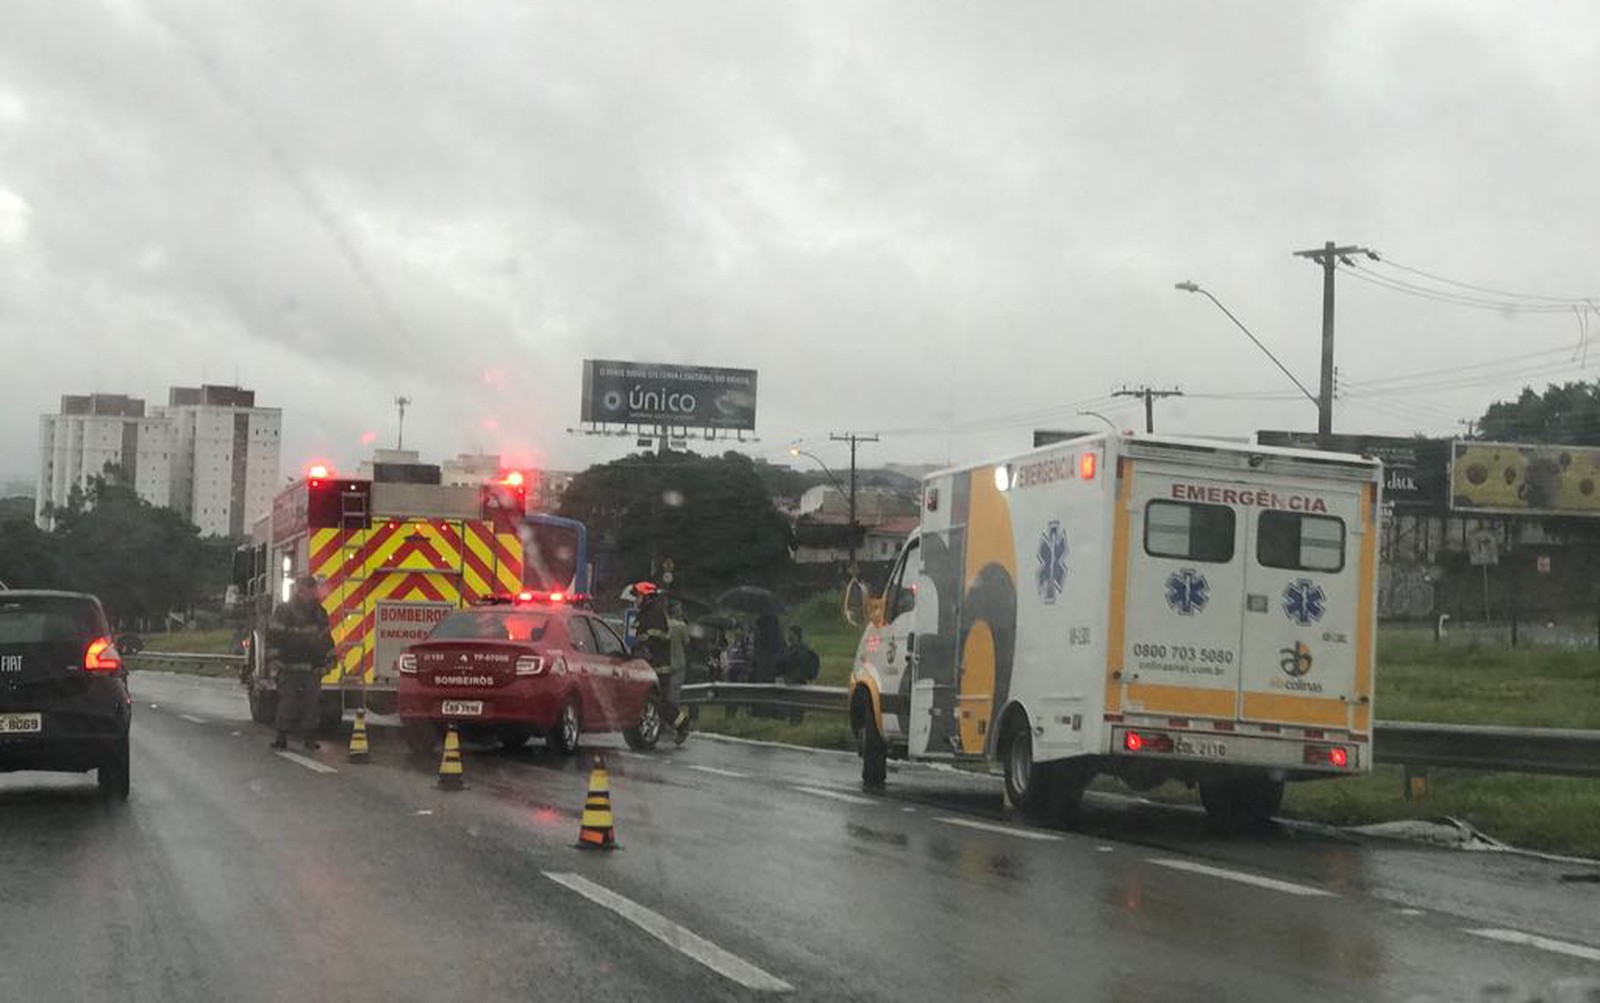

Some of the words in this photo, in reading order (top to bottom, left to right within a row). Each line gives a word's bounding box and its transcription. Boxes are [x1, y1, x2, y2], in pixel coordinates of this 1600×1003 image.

[629, 385, 696, 412] único
[1171, 483, 1327, 513] EMERGÊNCIA
[1133, 643, 1167, 659] 0800
[1171, 645, 1197, 661] 703
[1, 655, 23, 672] FIAT
[434, 675, 494, 686] BOMBEIROS
